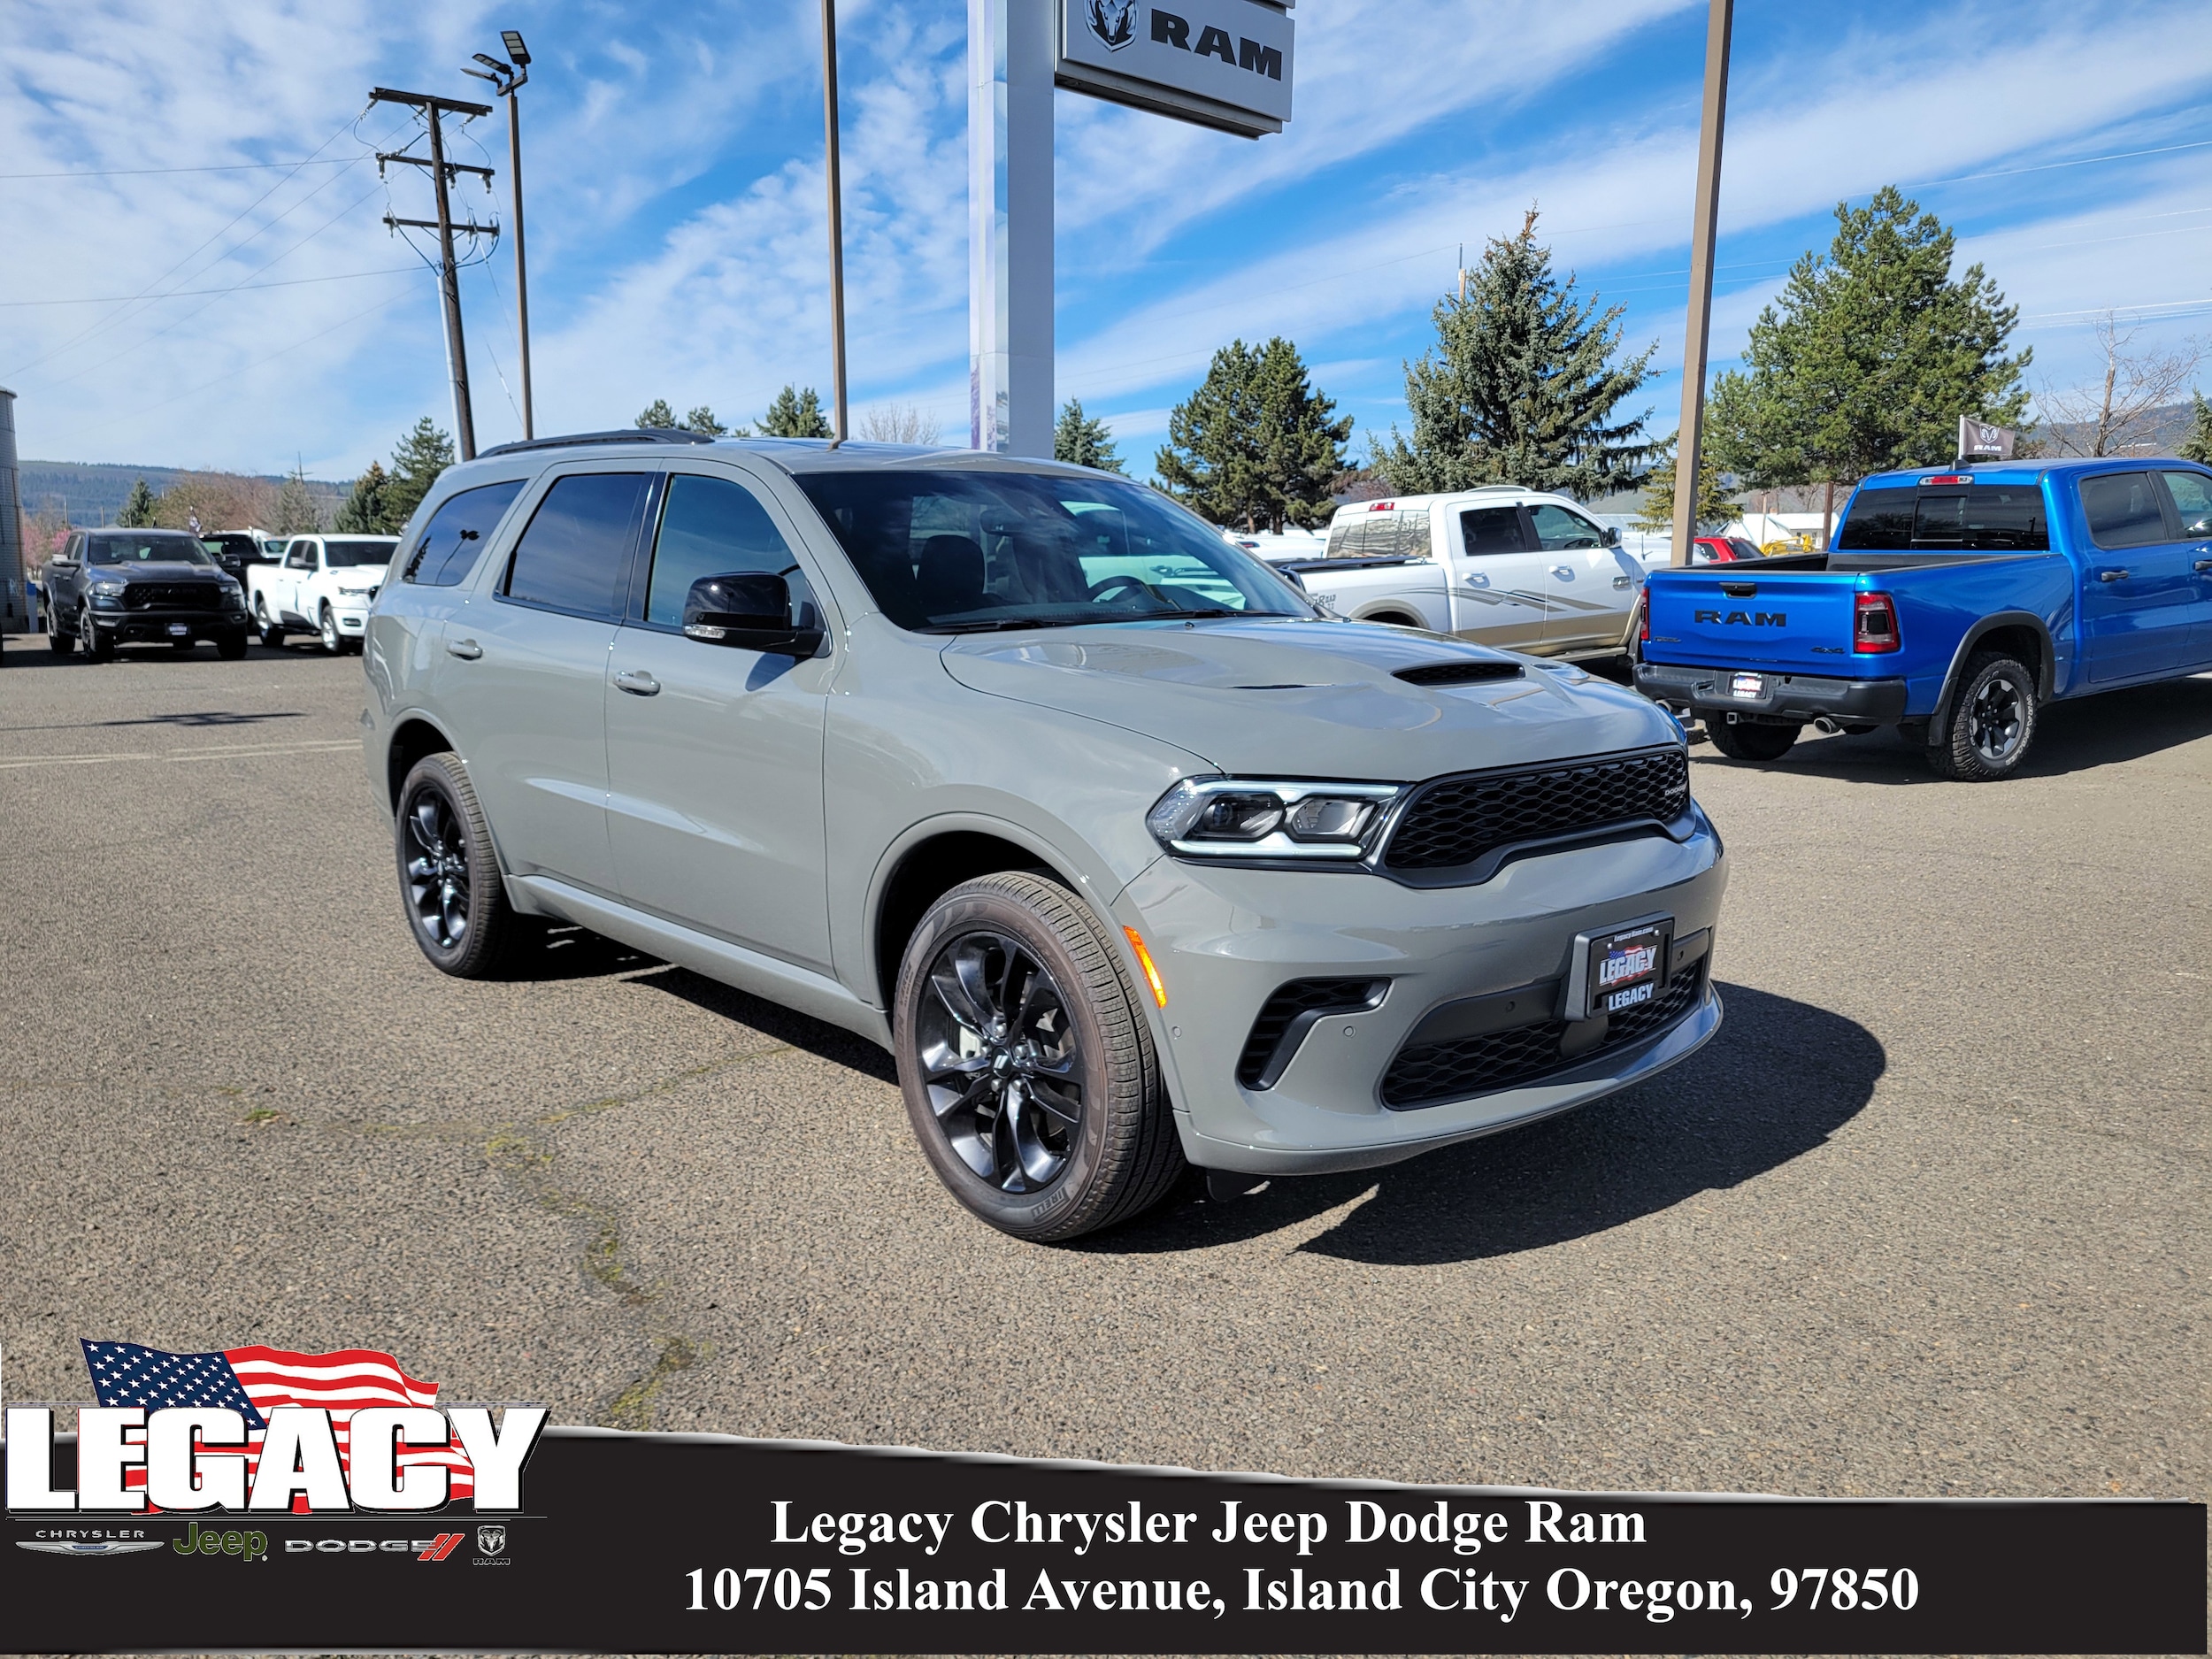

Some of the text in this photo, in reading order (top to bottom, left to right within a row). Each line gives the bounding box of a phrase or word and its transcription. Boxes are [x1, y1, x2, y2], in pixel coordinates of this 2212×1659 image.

[1151, 8, 1282, 81] RAM
[1694, 610, 1786, 627] RAM
[1599, 947, 1657, 986] LEGACY
[1608, 983, 1654, 1011] LEGACY
[1031, 1187, 1071, 1224] PIRELLI
